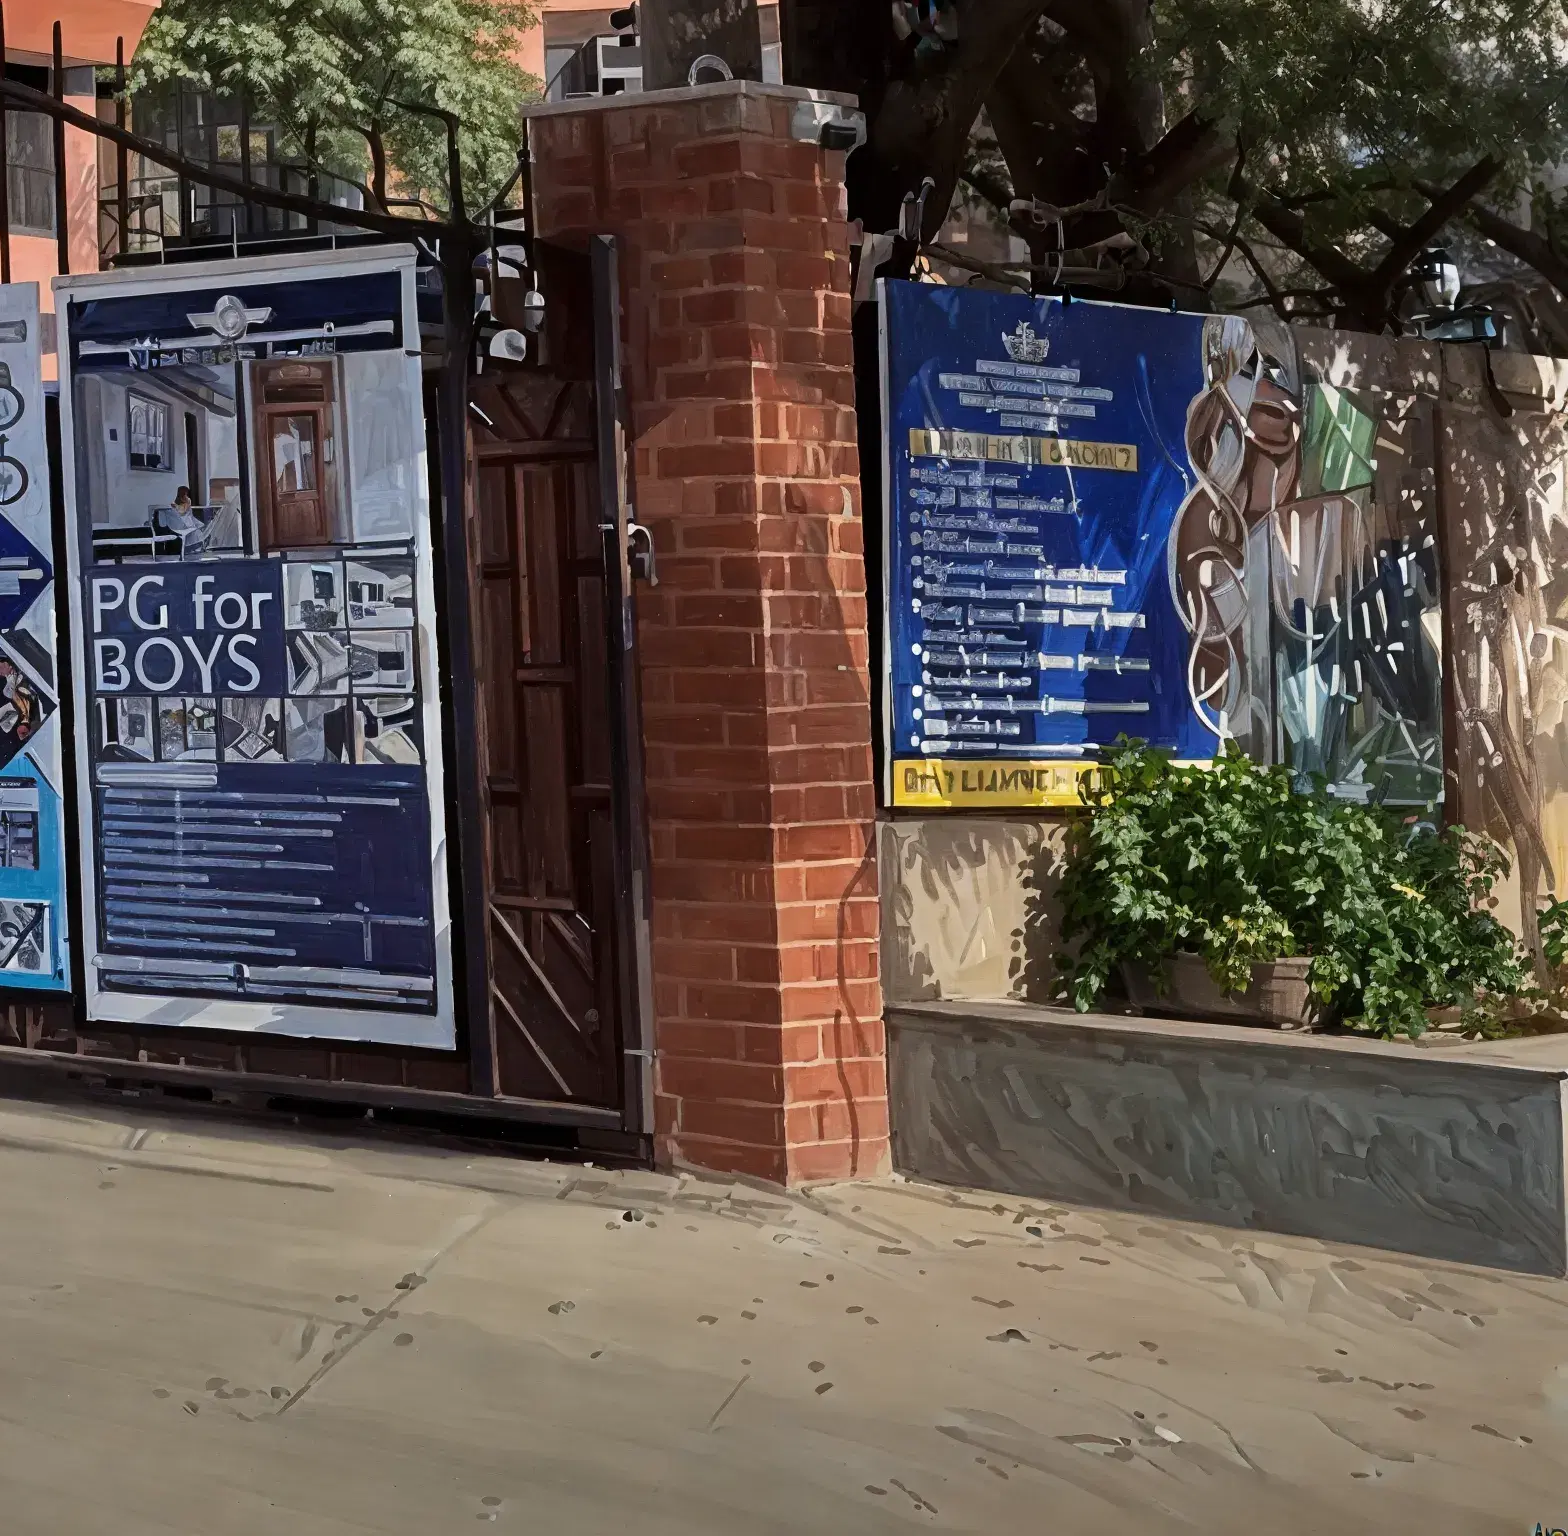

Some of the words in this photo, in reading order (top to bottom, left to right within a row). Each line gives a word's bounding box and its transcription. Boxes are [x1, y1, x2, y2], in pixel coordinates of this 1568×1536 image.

[91, 576, 170, 633] PG
[191, 574, 273, 632] for
[94, 633, 263, 693] BOYS
